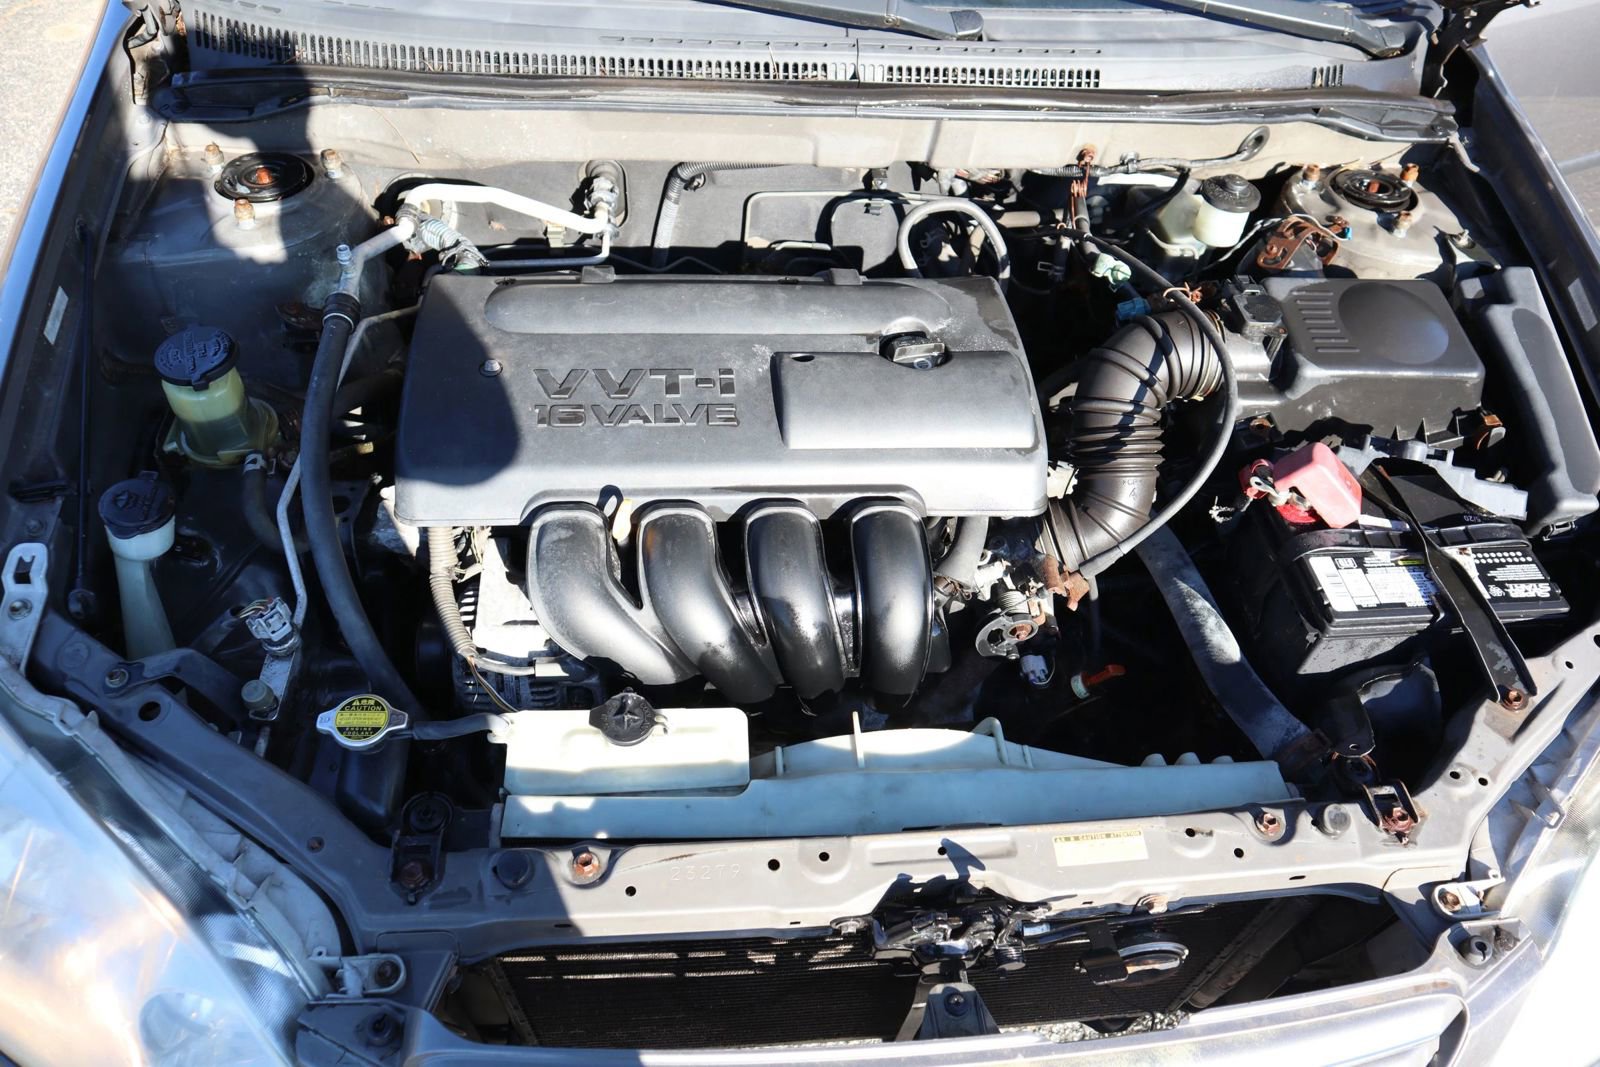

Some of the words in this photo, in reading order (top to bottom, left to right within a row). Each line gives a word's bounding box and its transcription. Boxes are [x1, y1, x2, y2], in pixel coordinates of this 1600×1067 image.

[533, 368, 736, 399] VVT-i
[534, 404, 586, 427] 16
[591, 404, 740, 427] VALVE
